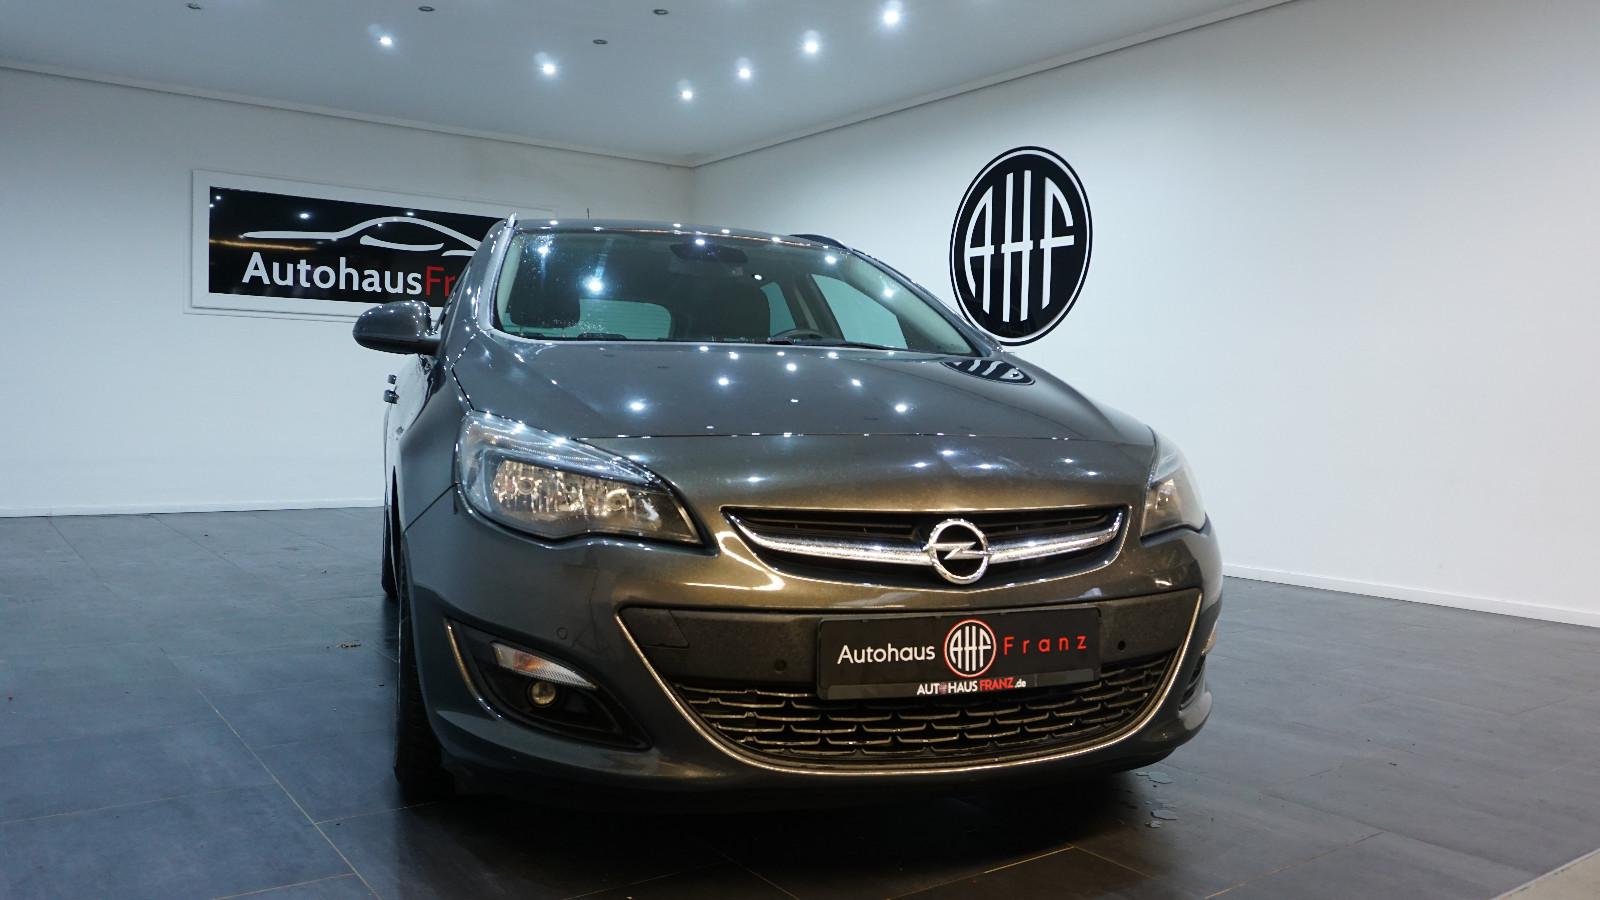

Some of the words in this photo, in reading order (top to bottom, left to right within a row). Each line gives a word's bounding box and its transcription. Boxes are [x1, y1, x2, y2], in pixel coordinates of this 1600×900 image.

[964, 170, 1075, 322] AHF
[241, 251, 456, 298] AutohausFr
[837, 643, 935, 664] Autohaus
[949, 625, 992, 672] AHF
[1003, 635, 1087, 656] Franz
